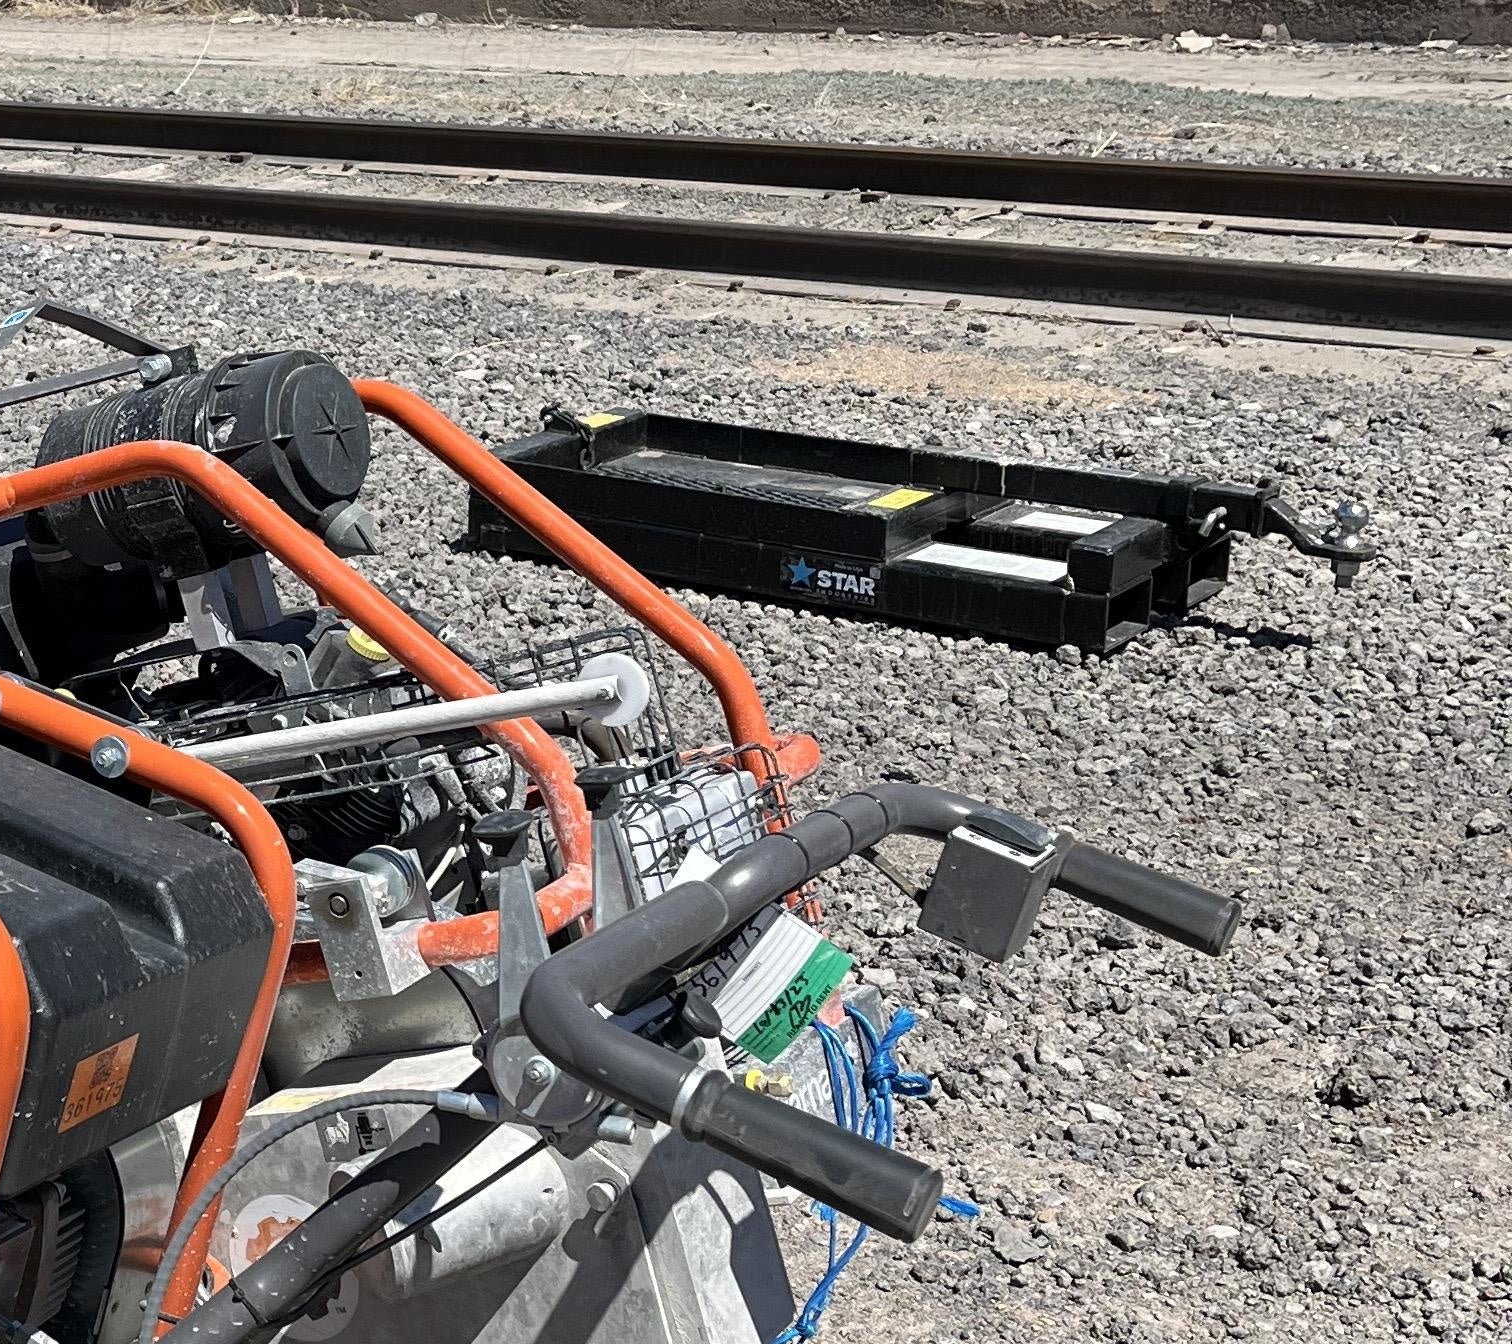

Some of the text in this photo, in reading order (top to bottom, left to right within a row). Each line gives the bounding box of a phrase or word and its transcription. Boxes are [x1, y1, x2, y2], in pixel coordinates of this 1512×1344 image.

[816, 569, 875, 596] STAR
[815, 983, 833, 1006] RENT
[64, 1076, 125, 1122] 361975
